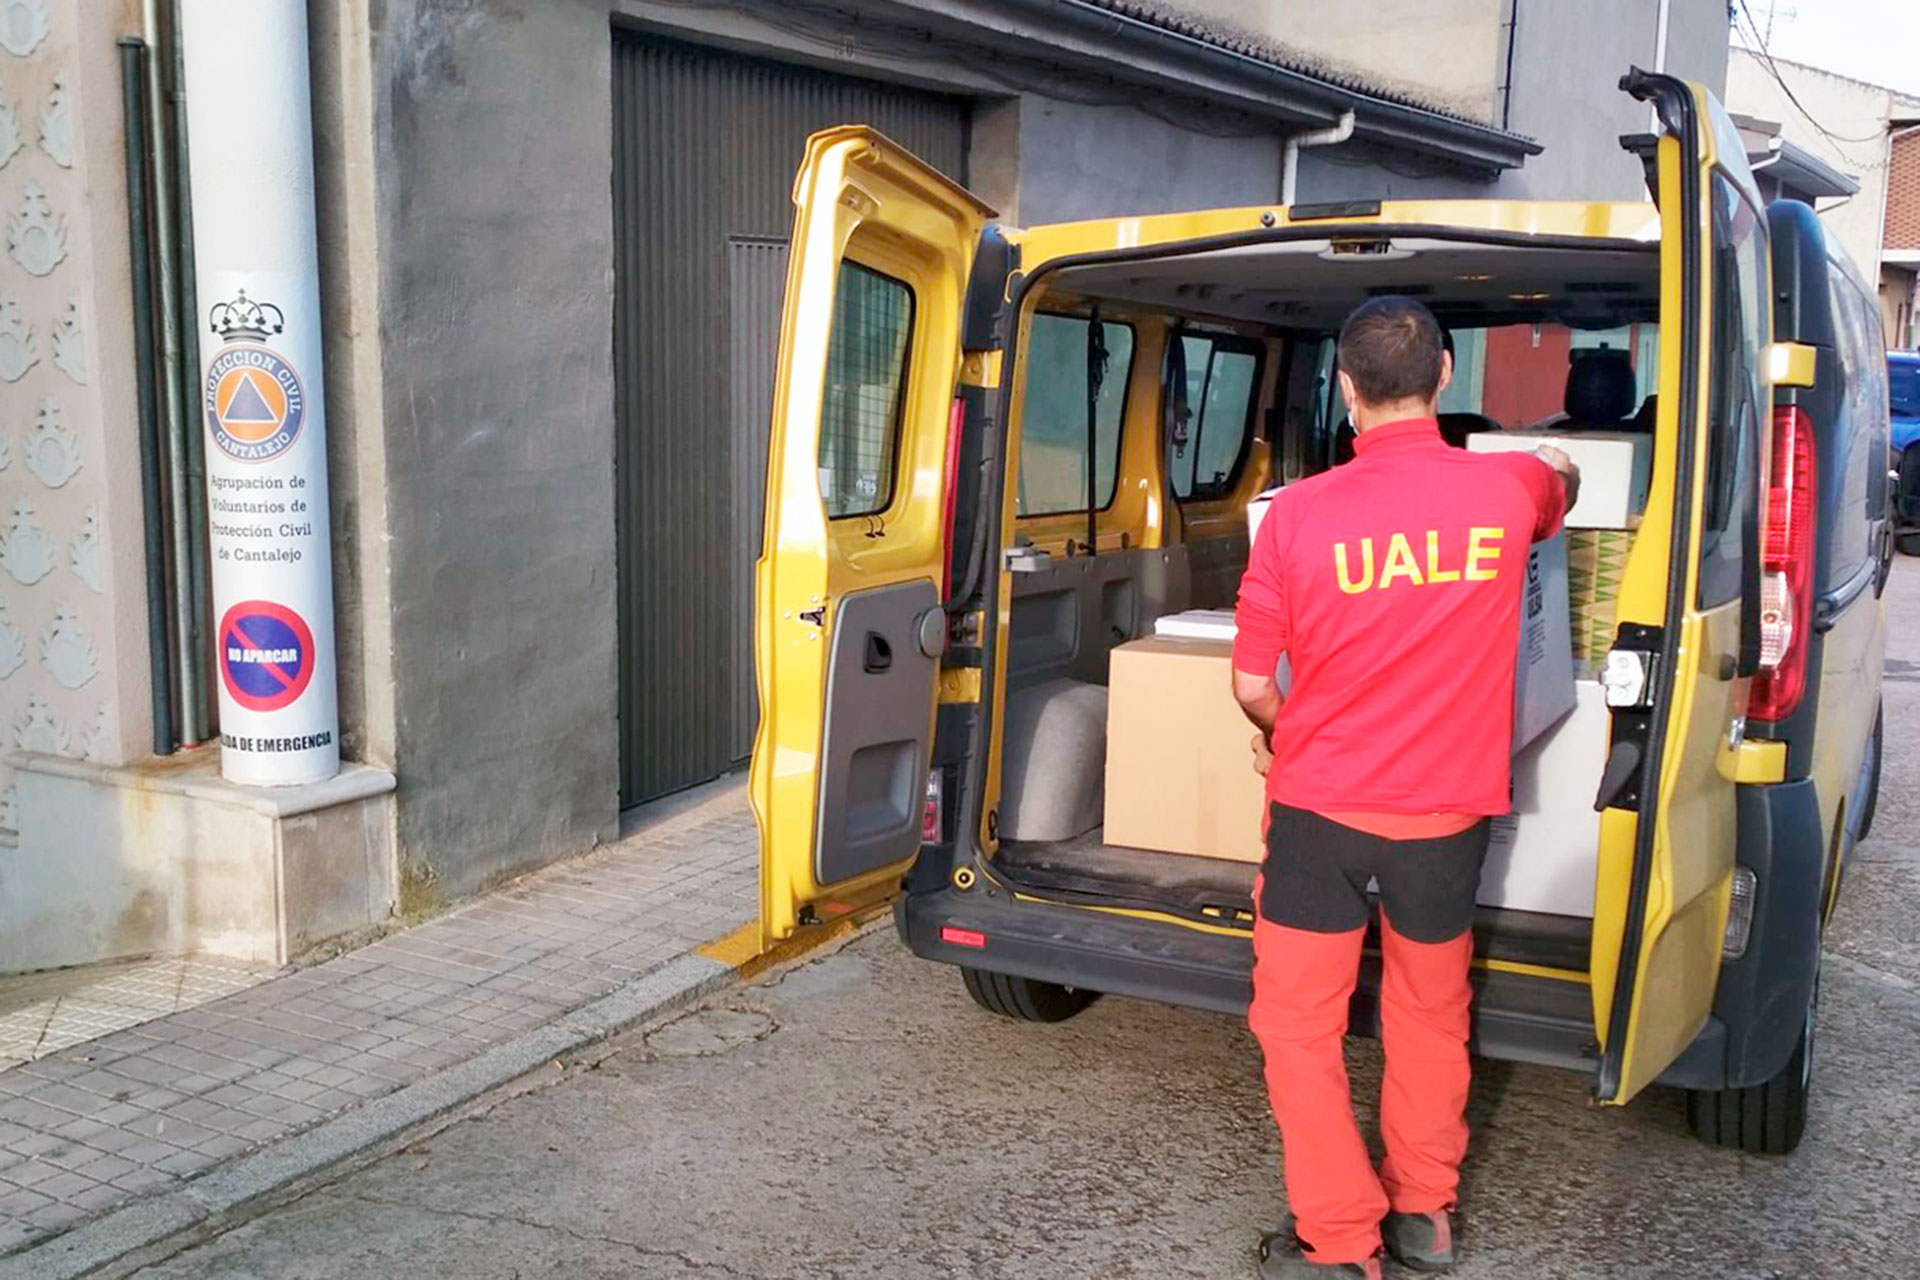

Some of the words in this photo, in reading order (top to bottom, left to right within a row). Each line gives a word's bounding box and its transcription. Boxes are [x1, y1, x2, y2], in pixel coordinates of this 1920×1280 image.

[207, 351, 276, 412] PROTECCION
[277, 368, 301, 413] CIVIL
[216, 430, 290, 458] CANTALEJO
[211, 475, 284, 491] Agrupación
[289, 475, 306, 488] de
[211, 498, 285, 513] Voluntarios
[290, 500, 307, 512] de
[211, 521, 273, 537] Protección
[279, 523, 312, 537] Civil
[219, 546, 231, 560] de
[234, 547, 302, 563] Cantalejo
[1334, 527, 1504, 594] UALE
[228, 648, 241, 662] NO
[243, 649, 297, 663] APARCAR
[240, 737, 253, 751] DE
[256, 731, 331, 752] EMERGENCIA
